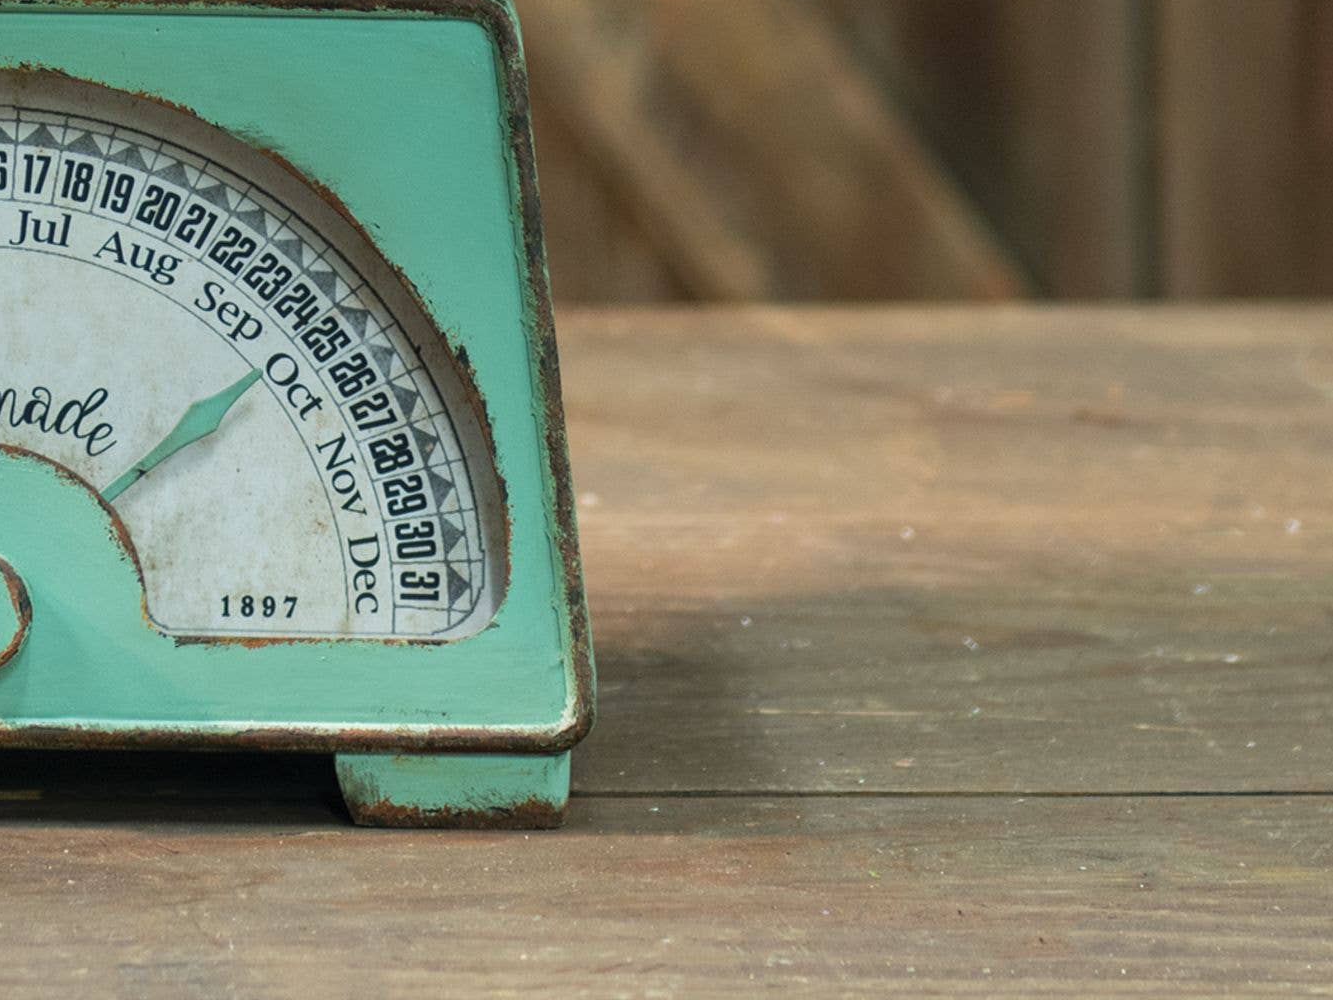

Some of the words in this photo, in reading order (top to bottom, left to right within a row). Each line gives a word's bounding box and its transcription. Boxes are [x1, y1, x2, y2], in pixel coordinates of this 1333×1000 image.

[23, 154, 51, 195] 17
[62, 159, 94, 202] 18
[99, 170, 134, 214] 19
[136, 185, 180, 231] 20
[175, 203, 217, 249] 21
[209, 226, 257, 275] 22
[243, 253, 292, 302] 23
[275, 283, 323, 331] 24
[301, 316, 351, 363] 25
[328, 352, 376, 399] 26
[10, 209, 72, 247] Jul
[94, 231, 183, 285] Aug
[194, 280, 263, 344] Sep
[264, 352, 323, 422] Oct
[316, 432, 367, 517] Nov
[347, 533, 382, 615] Dec
[349, 393, 398, 432] 27
[369, 434, 414, 474] 28
[383, 474, 427, 517] 29
[395, 520, 437, 560] 30
[220, 596, 298, 618] 1897
[400, 570, 440, 601] 31
